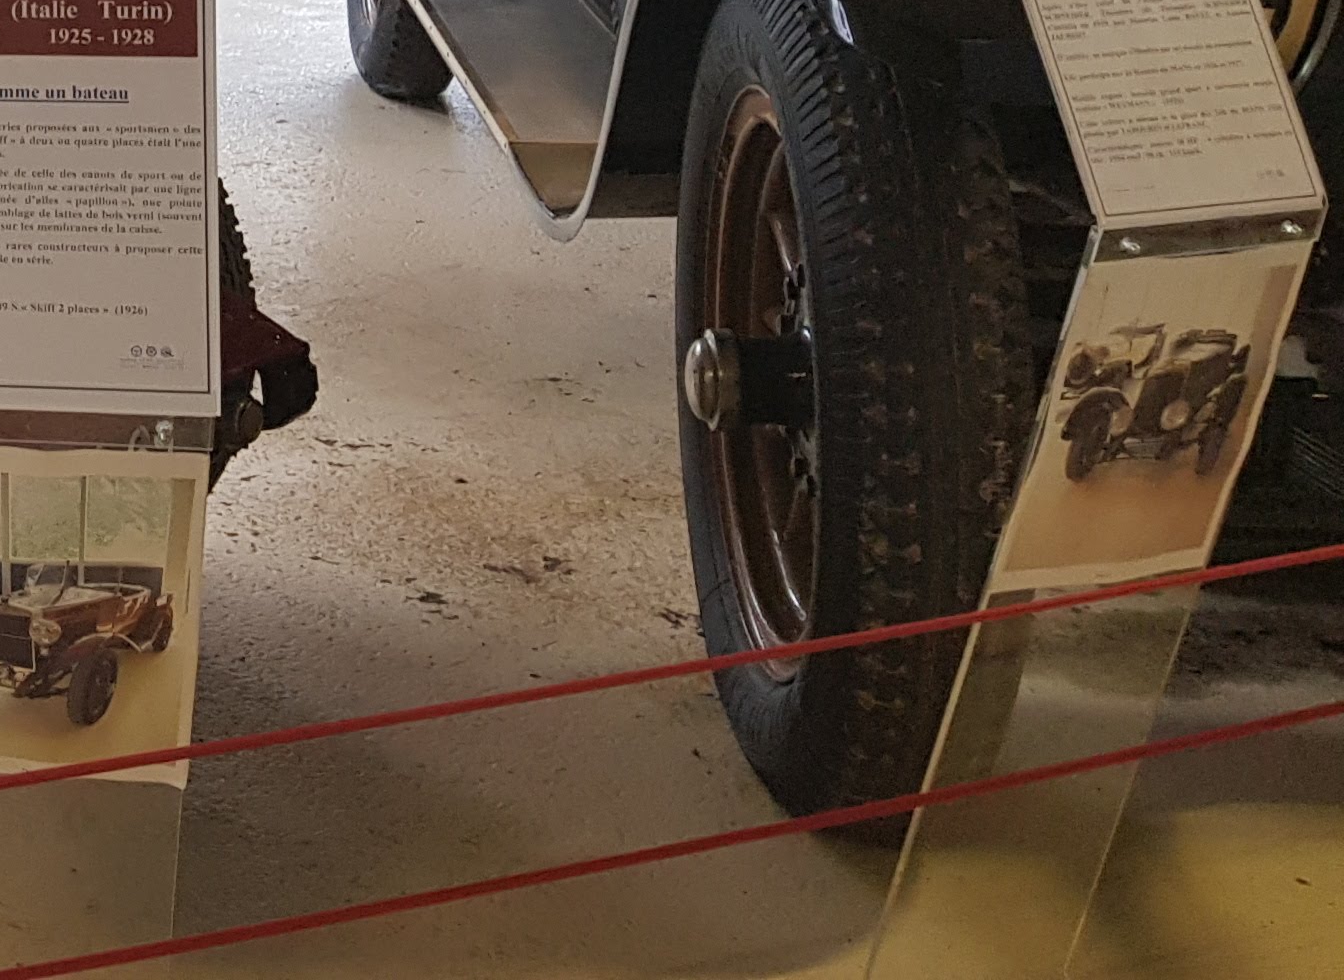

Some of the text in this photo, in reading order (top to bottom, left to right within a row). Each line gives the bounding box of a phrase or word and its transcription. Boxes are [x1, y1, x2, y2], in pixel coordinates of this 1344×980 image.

[11, 0, 78, 20] (Italie
[98, 0, 173, 23] Turin)
[49, 28, 92, 44] 1925
[111, 28, 155, 45] 1928
[45, 87, 66, 99] un
[72, 84, 129, 100] bateau
[26, 123, 77, 134] proposées
[82, 124, 100, 132] aux
[184, 125, 201, 133] des
[29, 136, 54, 145] deux
[74, 137, 108, 148] quatre
[113, 137, 144, 148] places
[14, 168, 27, 177] de
[31, 169, 54, 178] celle
[60, 169, 77, 178] des
[81, 170, 115, 179] canots
[120, 170, 133, 179] de
[138, 171, 166, 181] sport
[189, 172, 202, 180] de
[131, 185, 149, 195] par
[176, 185, 202, 195] ligne
[75, 197, 118, 207] papillon
[169, 199, 202, 209] pointe
[38, 208, 51, 217] de
[86, 210, 98, 219] de
[127, 211, 154, 220] verni
[20, 222, 33, 231] les
[101, 223, 113, 232] de
[116, 224, 126, 233] la
[6, 242, 33, 251] rares
[37, 243, 109, 252] constructeurs
[125, 245, 173, 255] proposer
[177, 246, 203, 254] cette
[11, 256, 23, 264] en
[58, 304, 64, 312] 2
[67, 304, 100, 315] places
[114, 305, 148, 316] (1926)
